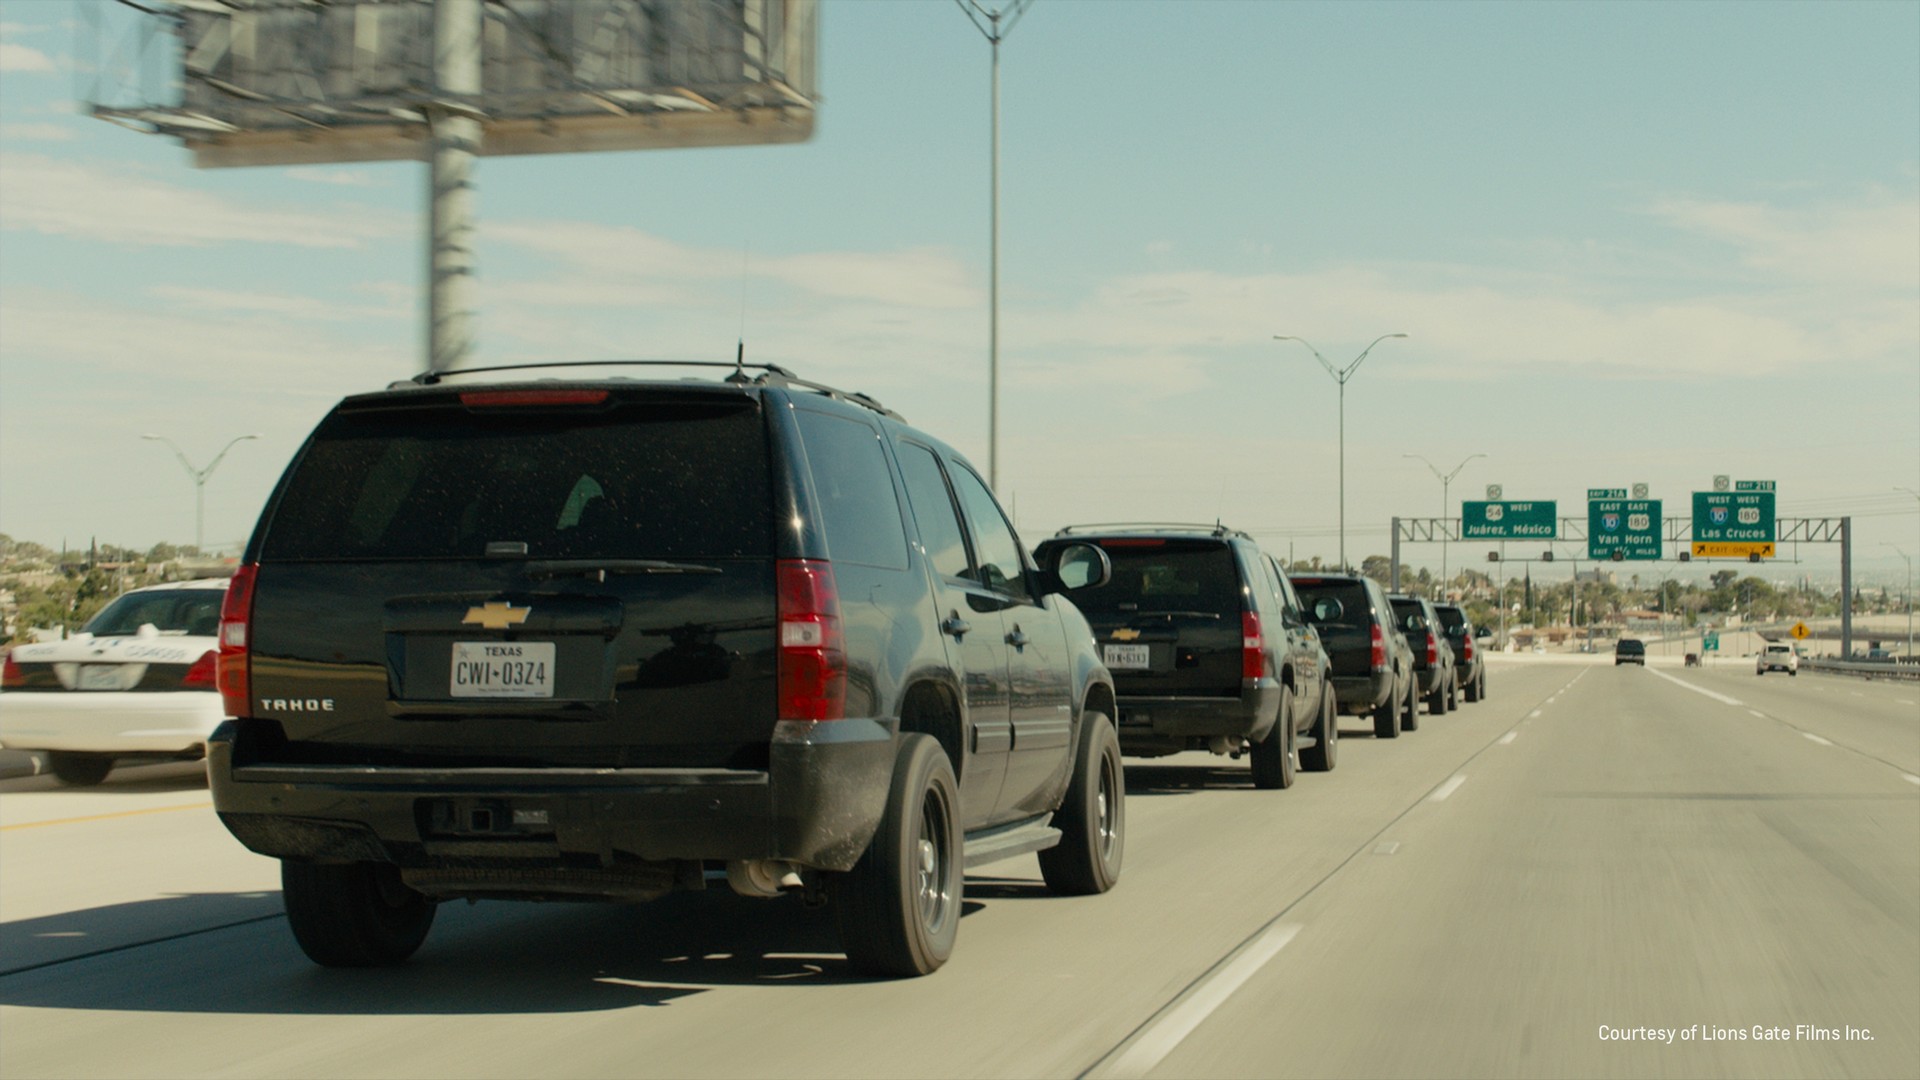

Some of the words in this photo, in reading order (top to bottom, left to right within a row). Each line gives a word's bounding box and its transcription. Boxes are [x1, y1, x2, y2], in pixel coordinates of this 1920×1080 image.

[1707, 496, 1730, 504] WEST
[1736, 496, 1760, 504] WEST
[1510, 503, 1533, 511] WEST
[1600, 503, 1621, 511] EAST
[1627, 503, 1649, 511] EAST
[1487, 507, 1501, 518] 54
[1714, 512, 1724, 522] 10
[1739, 510, 1758, 520] 180
[1605, 518, 1617, 528] 10
[1630, 517, 1648, 527] 180
[1513, 524, 1551, 535] México
[1701, 528, 1720, 538] Las
[1726, 528, 1766, 538] Cruces
[1598, 535, 1619, 544] Van
[1625, 534, 1652, 544] Horn
[1732, 546, 1755, 554] ONLY
[485, 646, 523, 657] TEXAS
[261, 699, 334, 711] TAHOE
